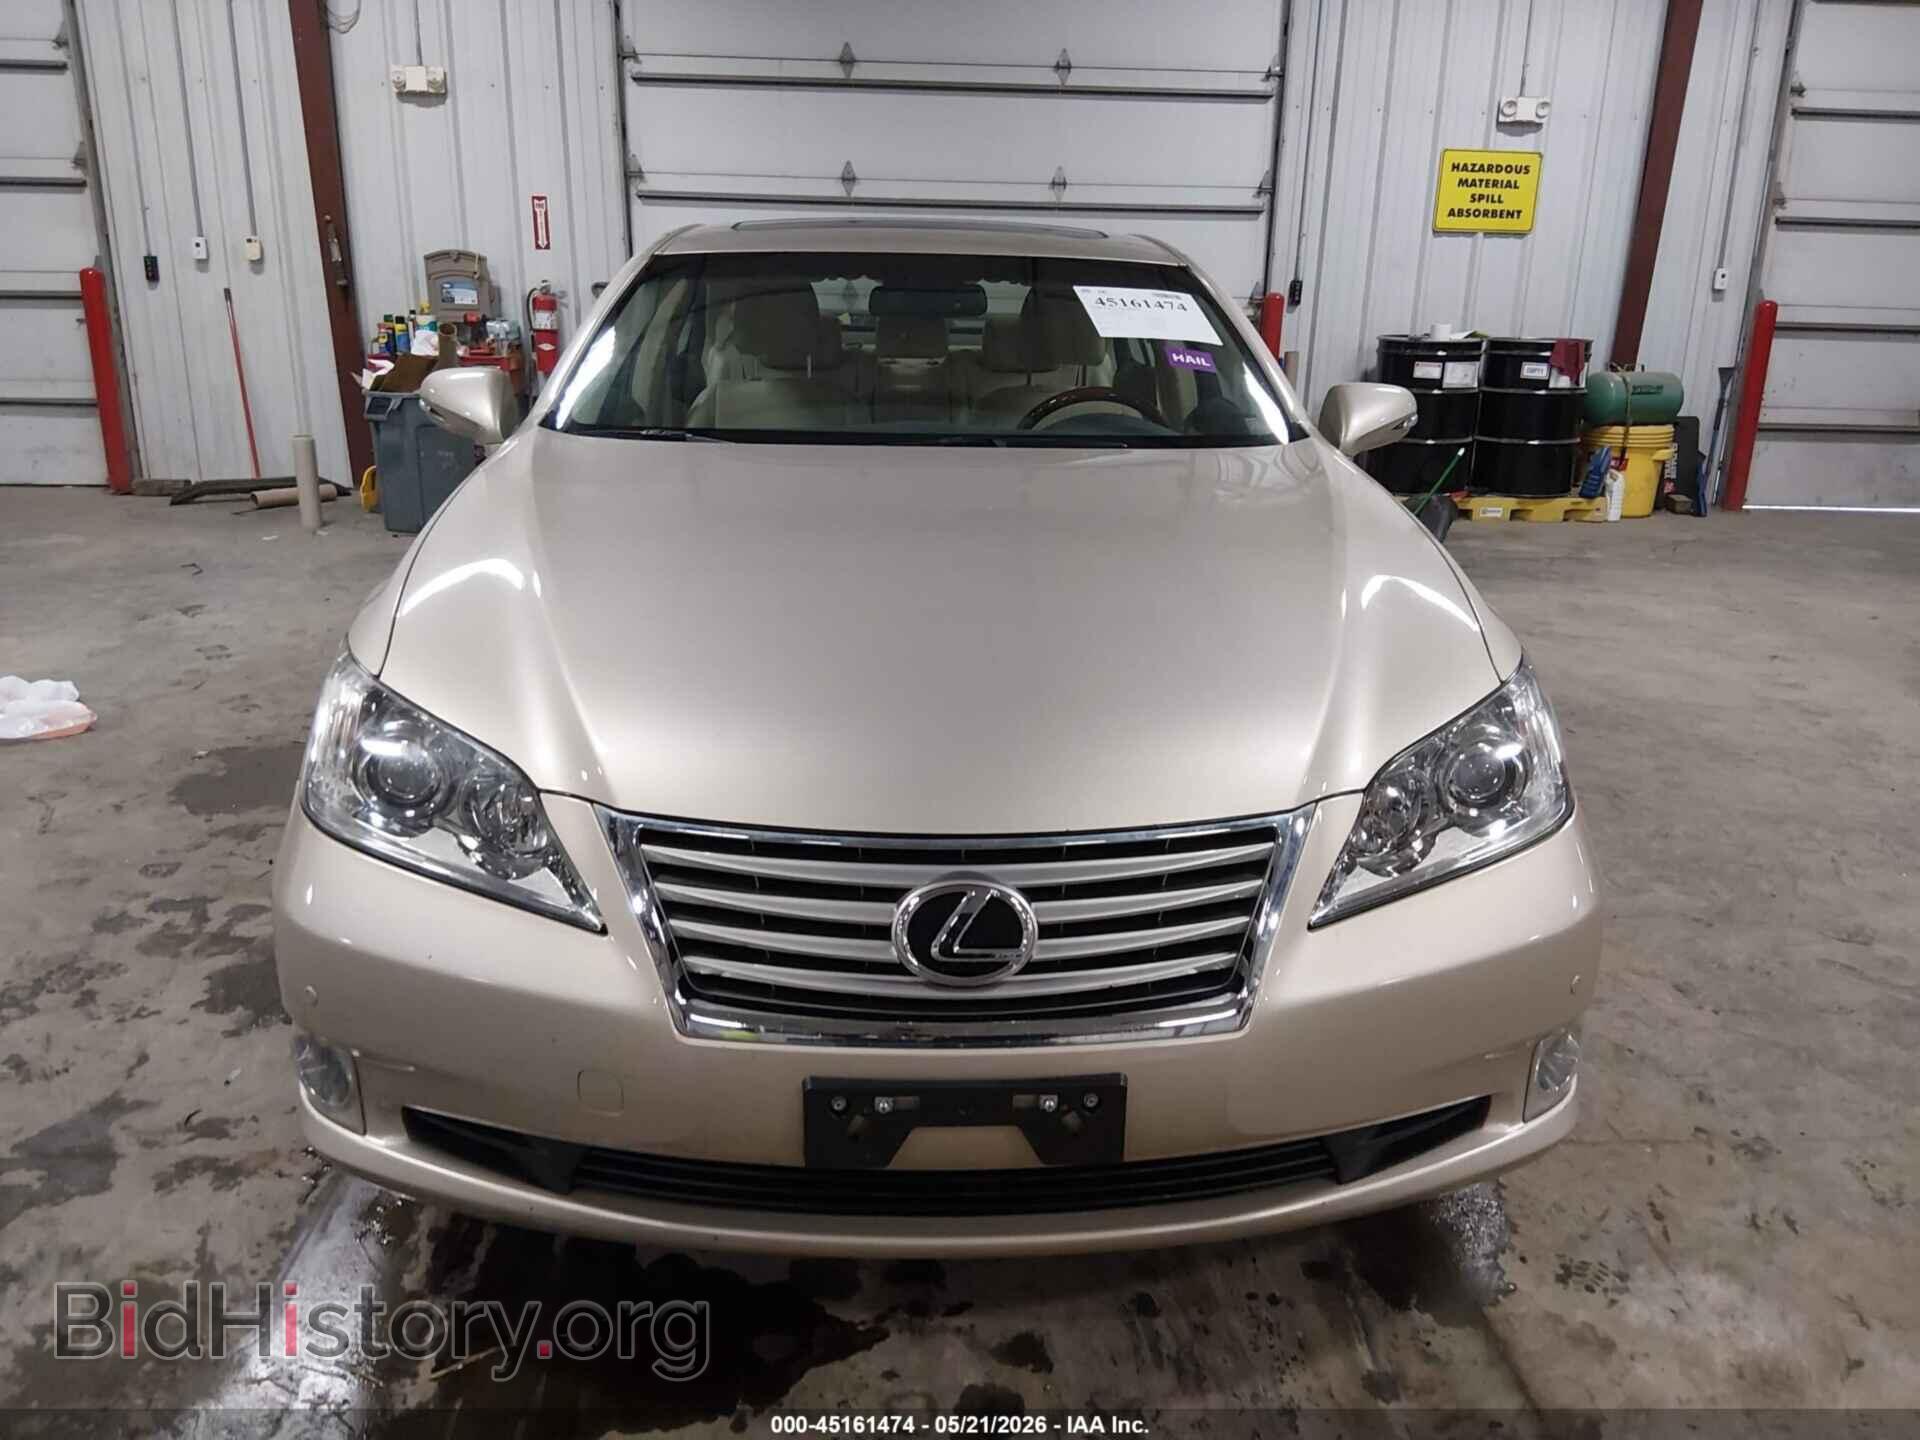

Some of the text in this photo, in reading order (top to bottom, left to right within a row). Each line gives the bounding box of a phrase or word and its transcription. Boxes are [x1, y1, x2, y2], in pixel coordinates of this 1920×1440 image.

[1451, 162, 1531, 175] HAZARDOUS
[1457, 178, 1520, 189] MATERIAL
[1469, 193, 1504, 204] SPILL
[1447, 208, 1523, 219] ABSORBENT
[1094, 296, 1188, 312] 45161474
[1171, 353, 1212, 367] HAIL
